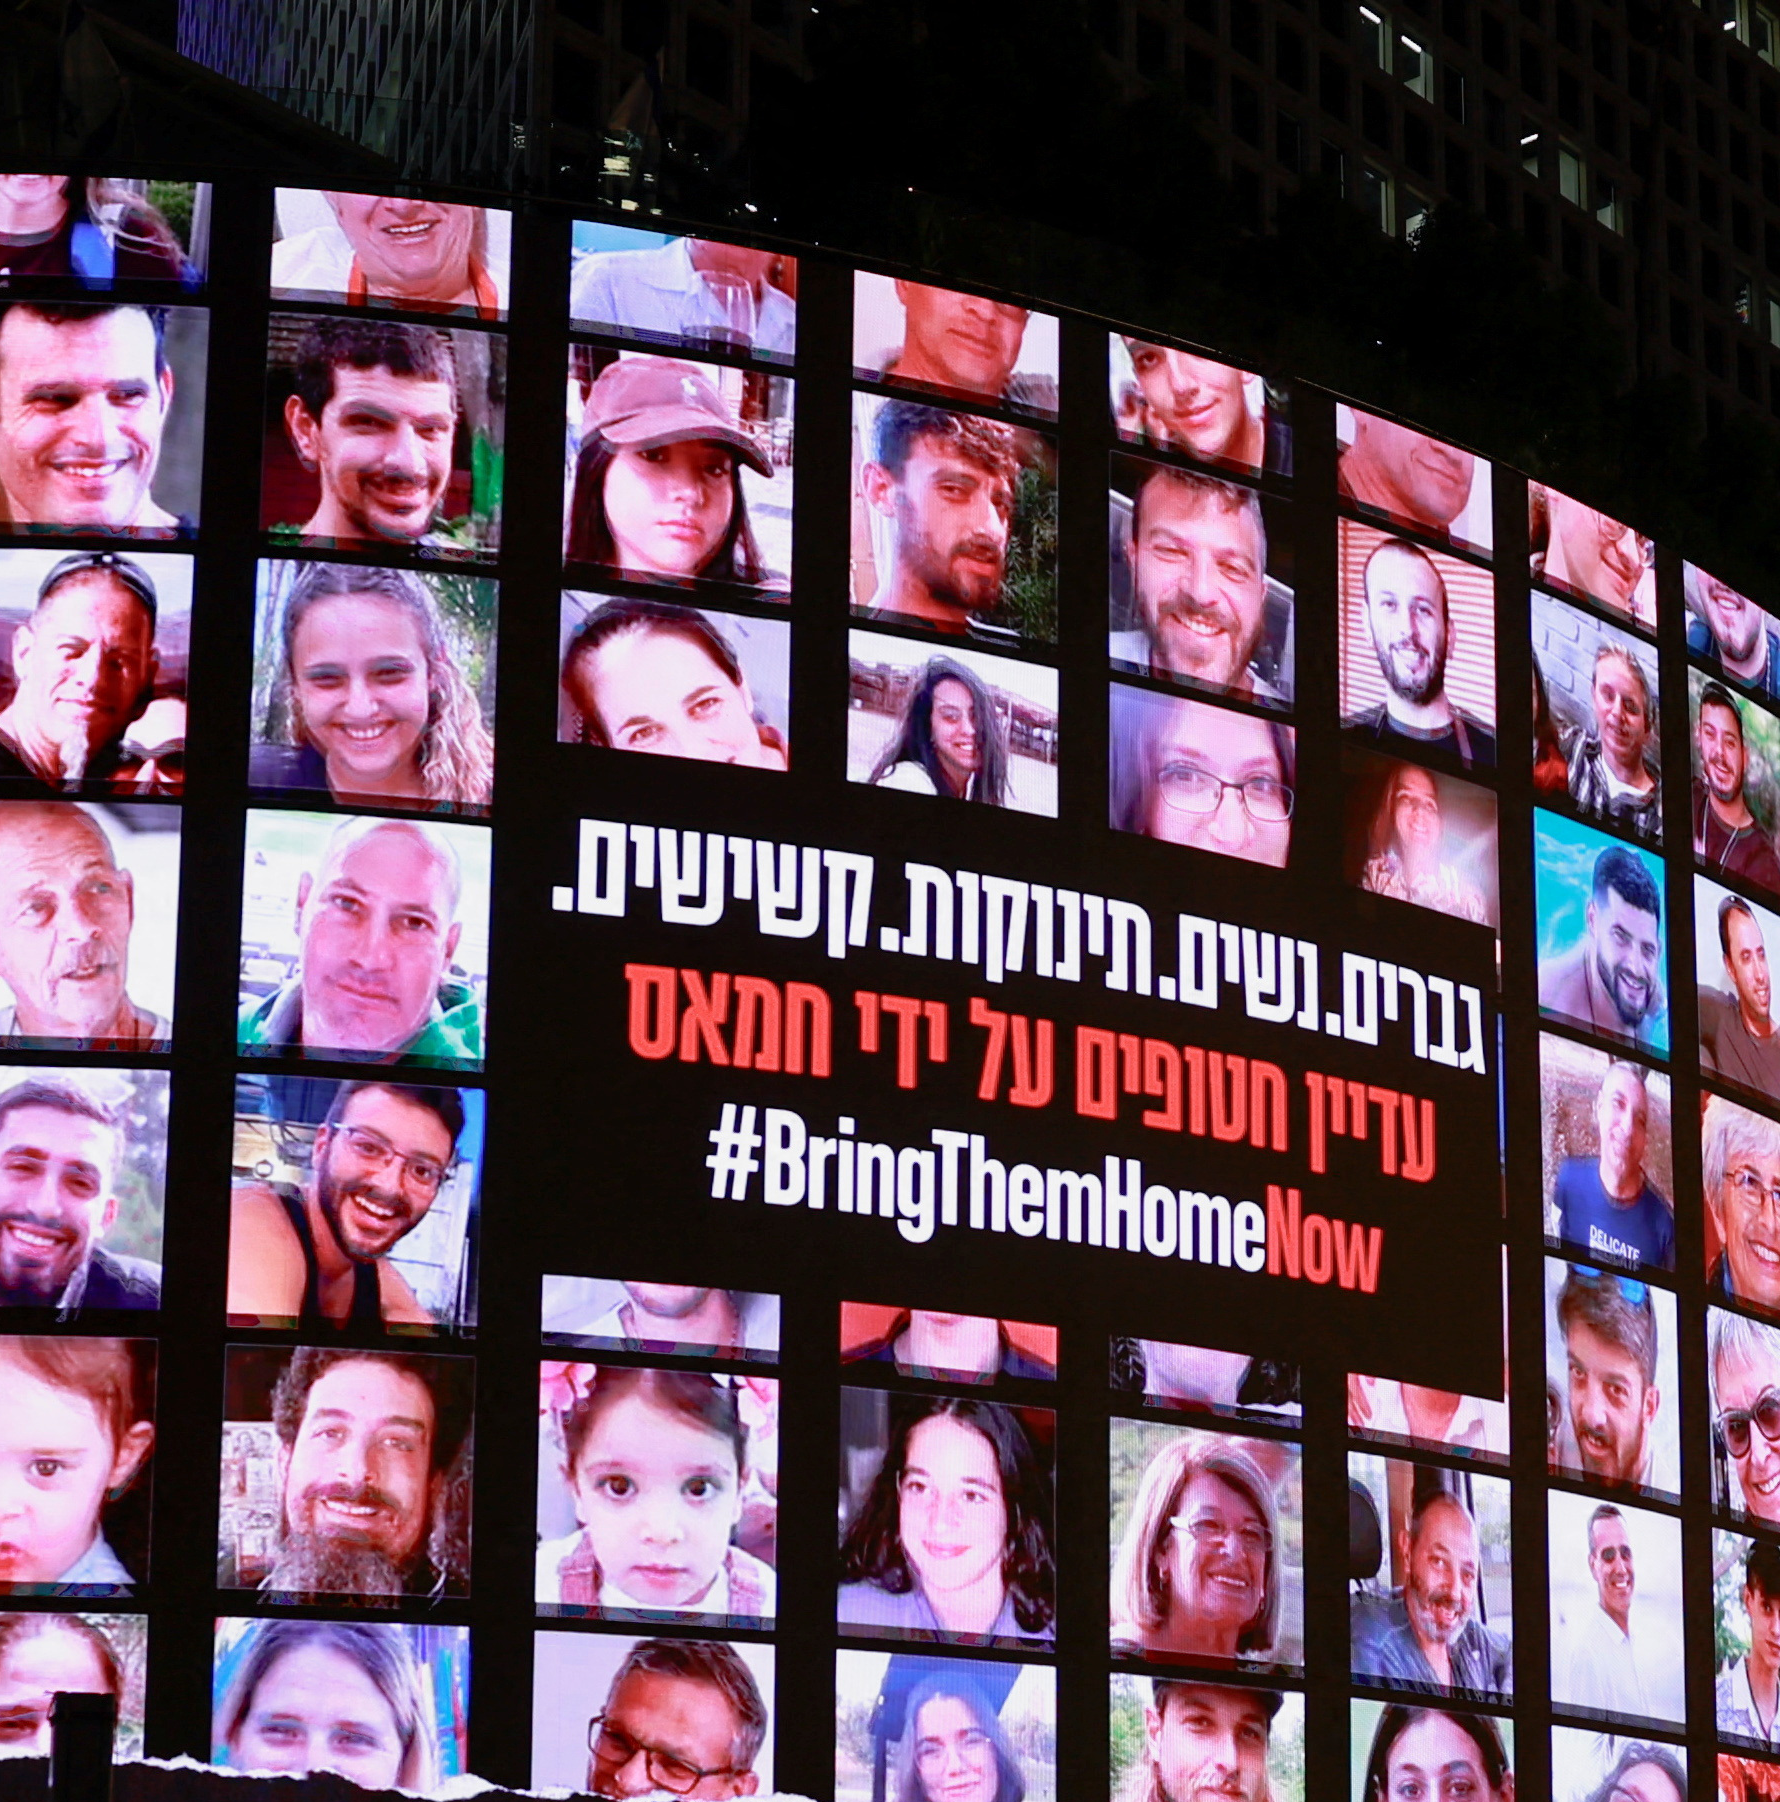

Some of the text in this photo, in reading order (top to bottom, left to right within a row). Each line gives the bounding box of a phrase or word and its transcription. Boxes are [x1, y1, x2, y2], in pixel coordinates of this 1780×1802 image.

[624, 962, 1436, 1184] עדיין חטופים על ידי חמאס
[705, 1102, 1384, 1295] #BringThemHomeNow
